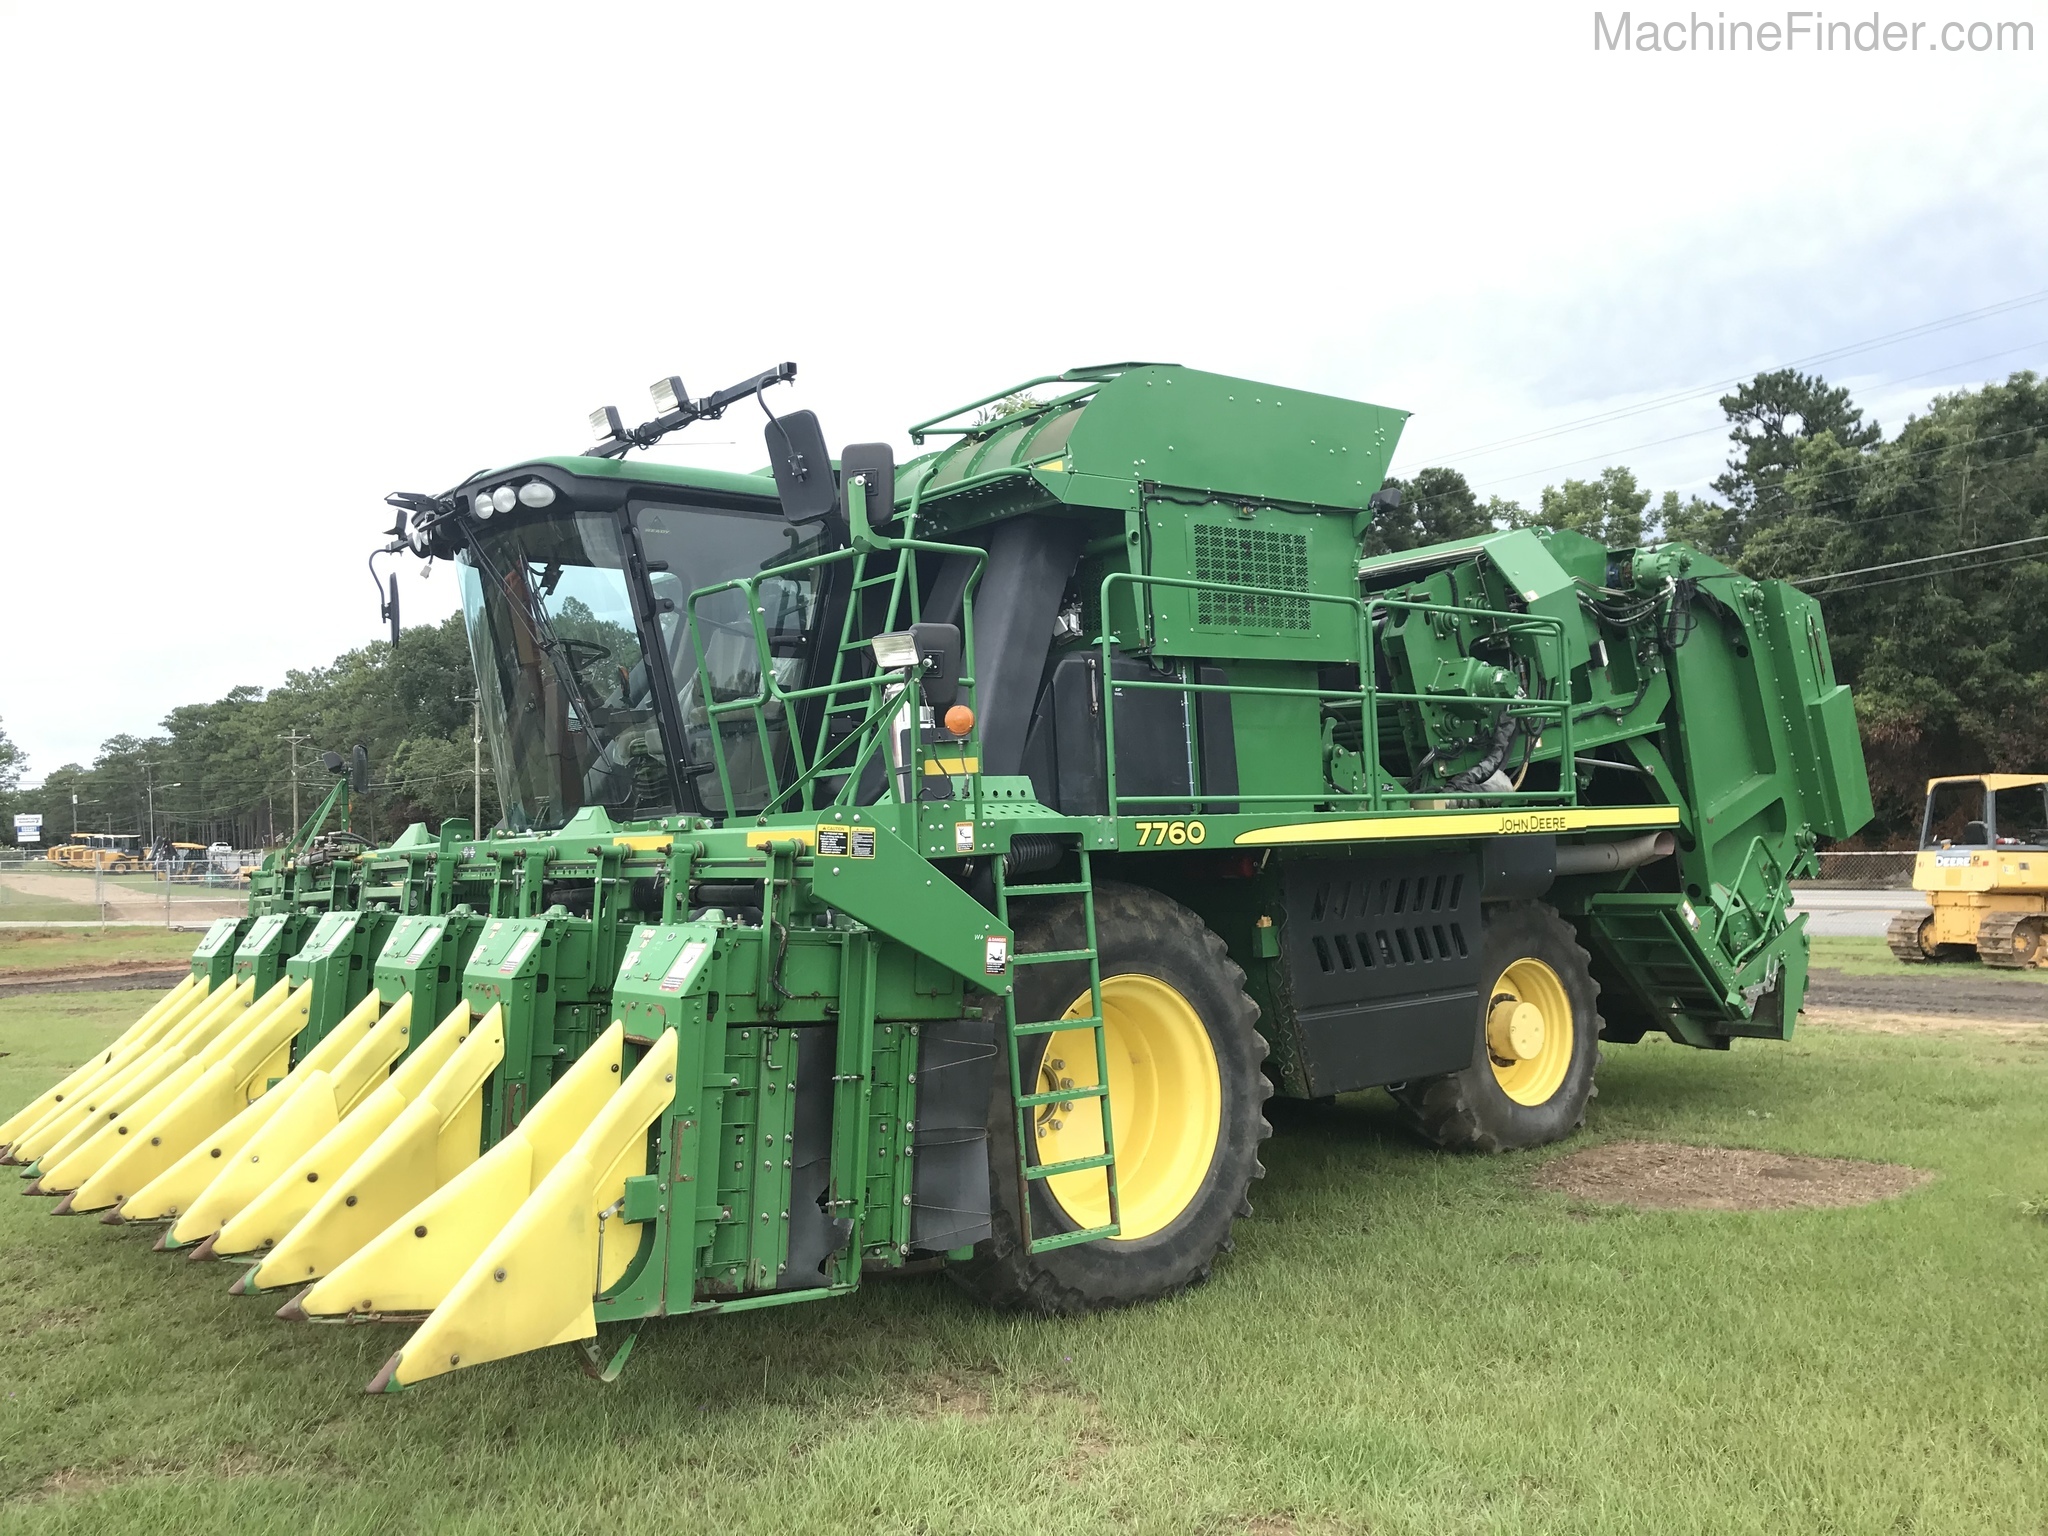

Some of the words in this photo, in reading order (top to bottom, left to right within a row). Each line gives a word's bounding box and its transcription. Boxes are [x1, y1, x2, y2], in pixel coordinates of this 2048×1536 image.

[1499, 817, 1529, 832] JOHN
[1530, 815, 1567, 830] DEERE
[1135, 820, 1207, 847] 7760
[1936, 856, 1971, 868] DEERE
